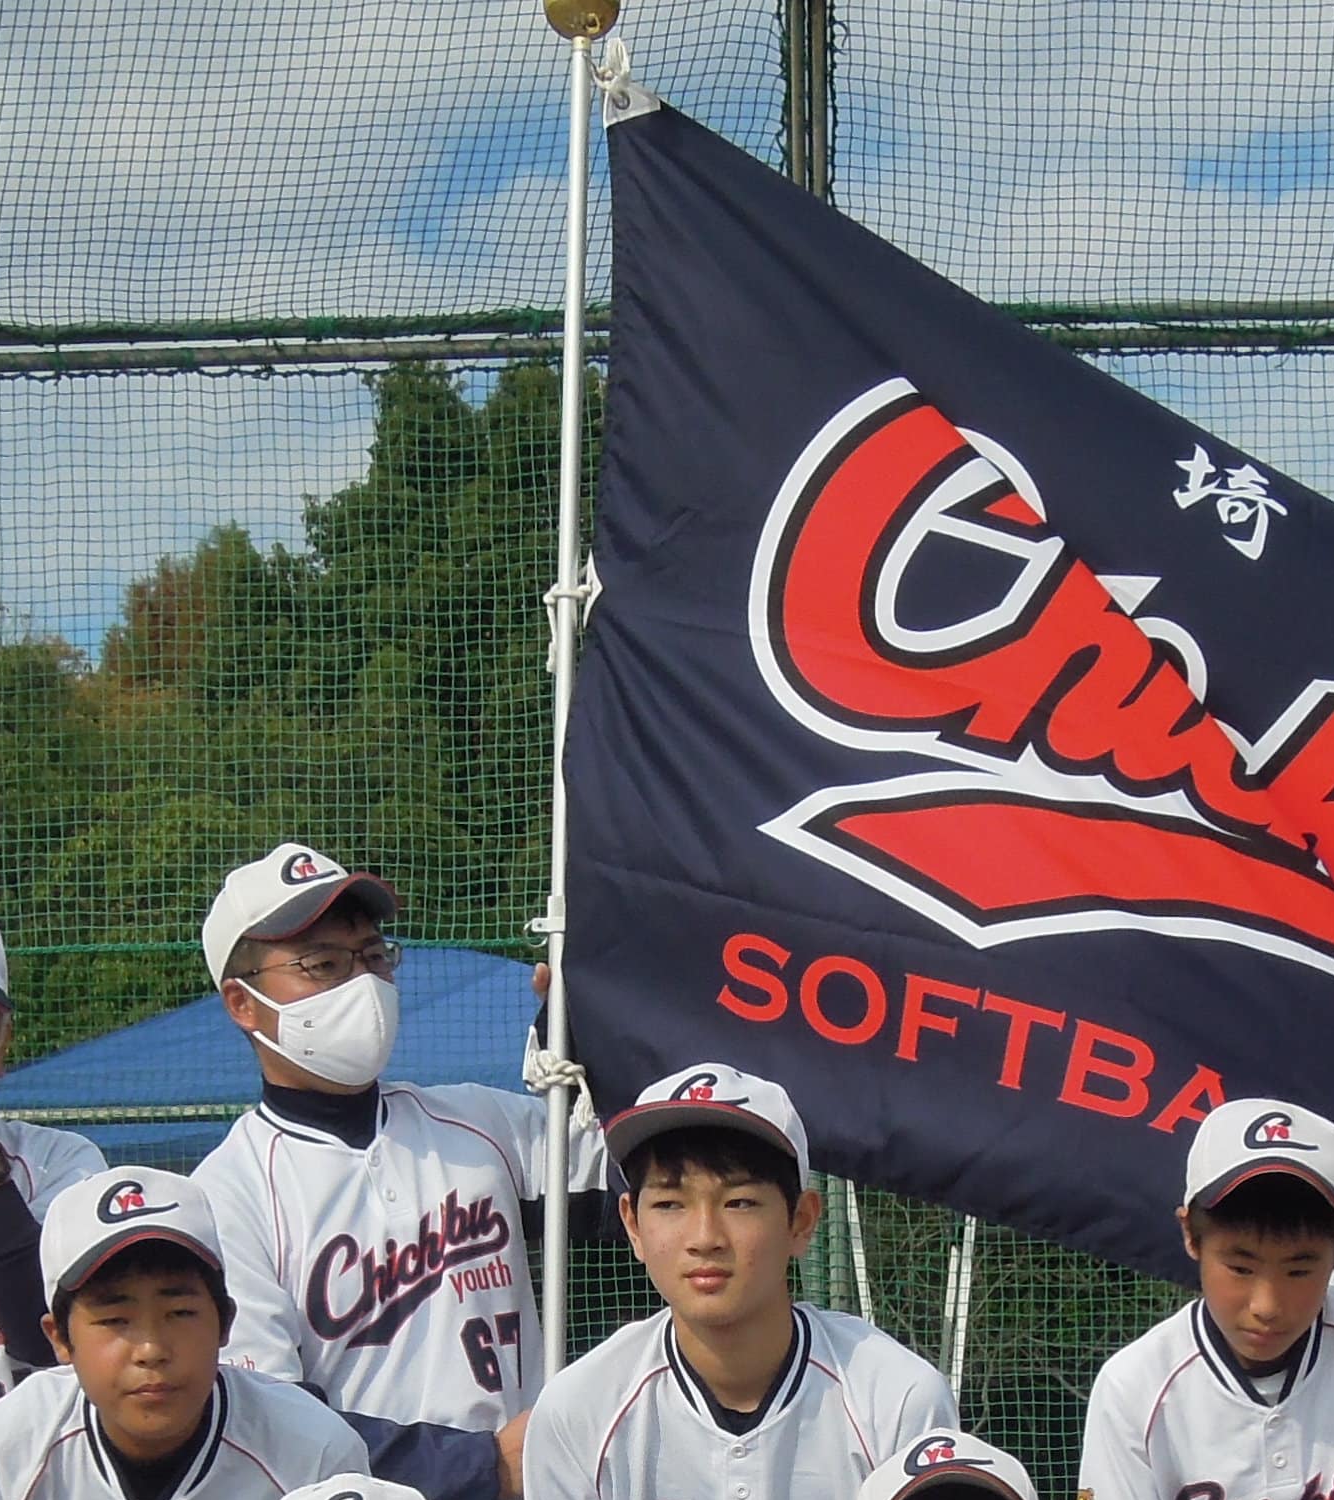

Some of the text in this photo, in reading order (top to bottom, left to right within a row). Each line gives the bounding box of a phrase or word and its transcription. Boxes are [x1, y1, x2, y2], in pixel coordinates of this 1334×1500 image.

[307, 1189, 508, 1340] Chichbu
[450, 1256, 513, 1302] youth
[462, 1312, 522, 1393] 67
